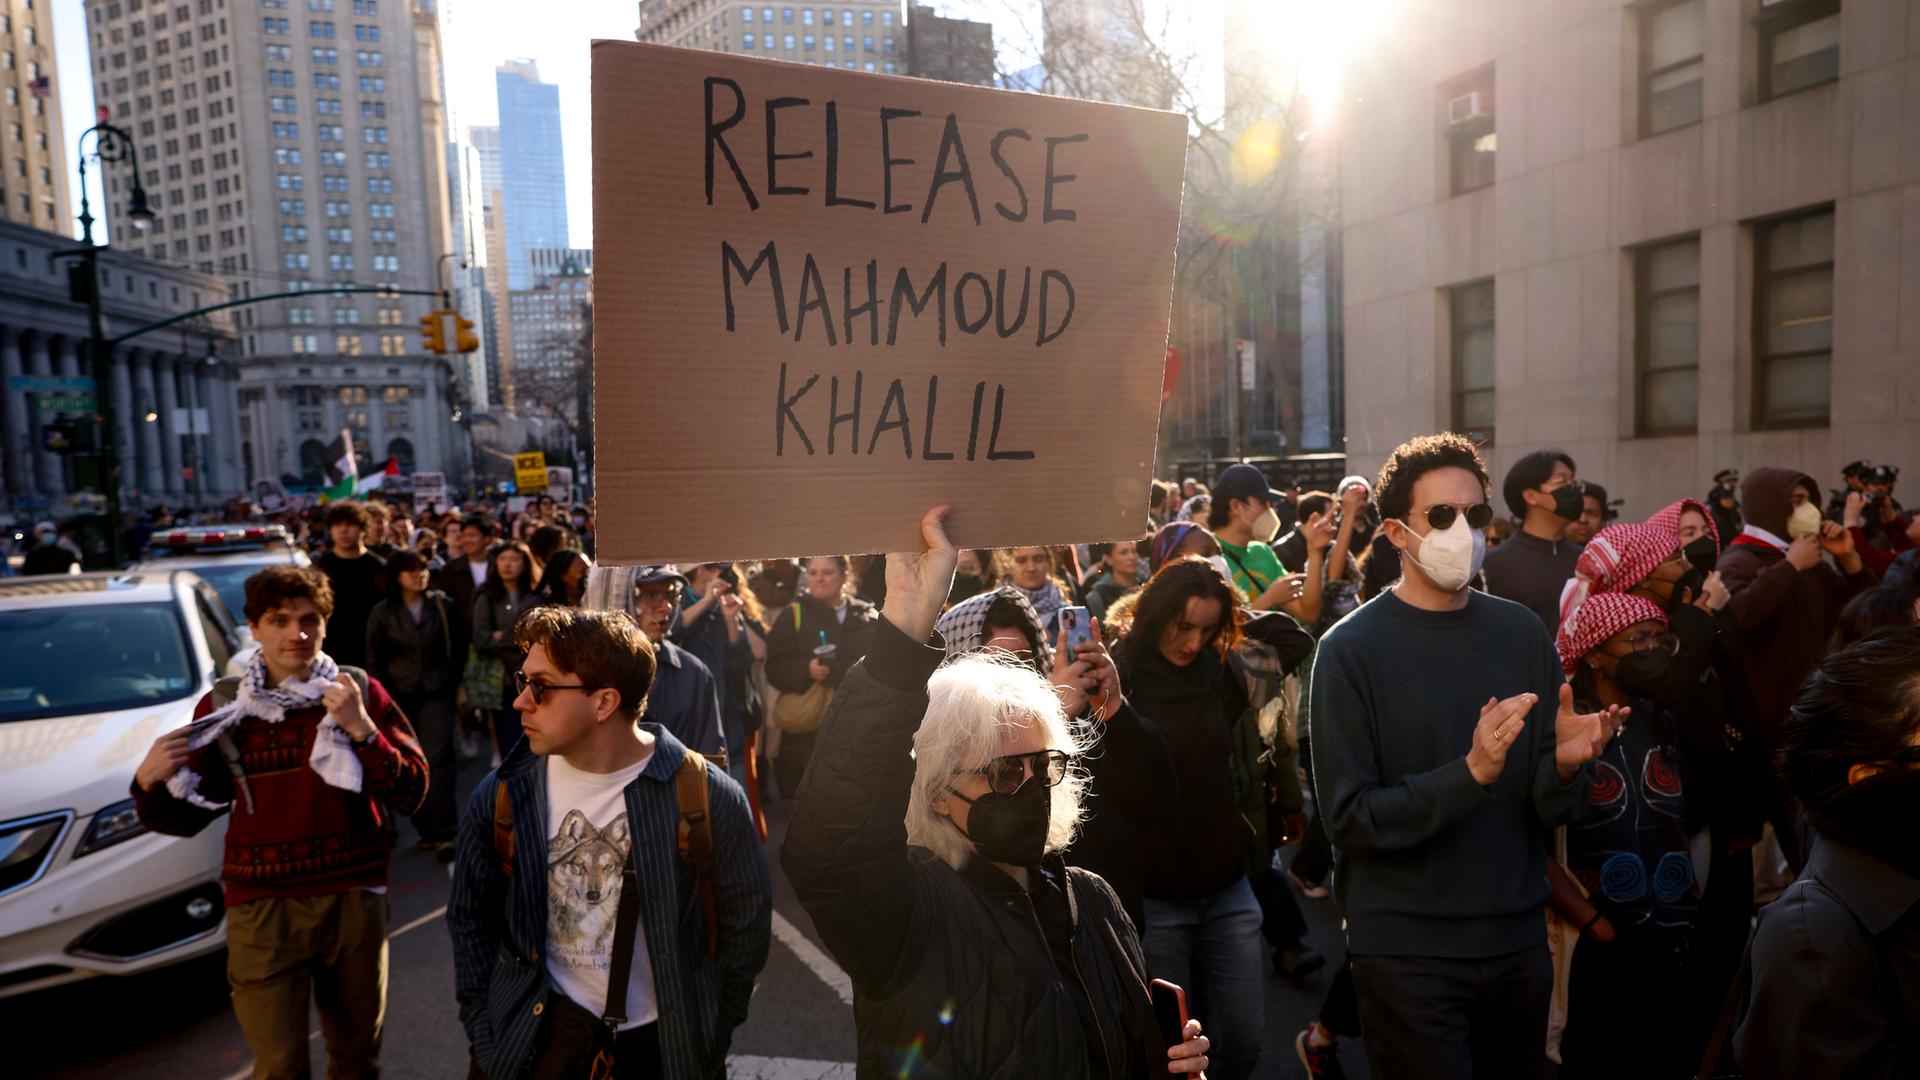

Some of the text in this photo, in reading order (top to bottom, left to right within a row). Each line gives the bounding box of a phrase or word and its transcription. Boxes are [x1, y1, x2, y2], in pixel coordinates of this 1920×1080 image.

[704, 76, 1089, 226] RELEASE
[721, 240, 1076, 347] MAHMOUD
[776, 362, 1036, 461] KHALIL
